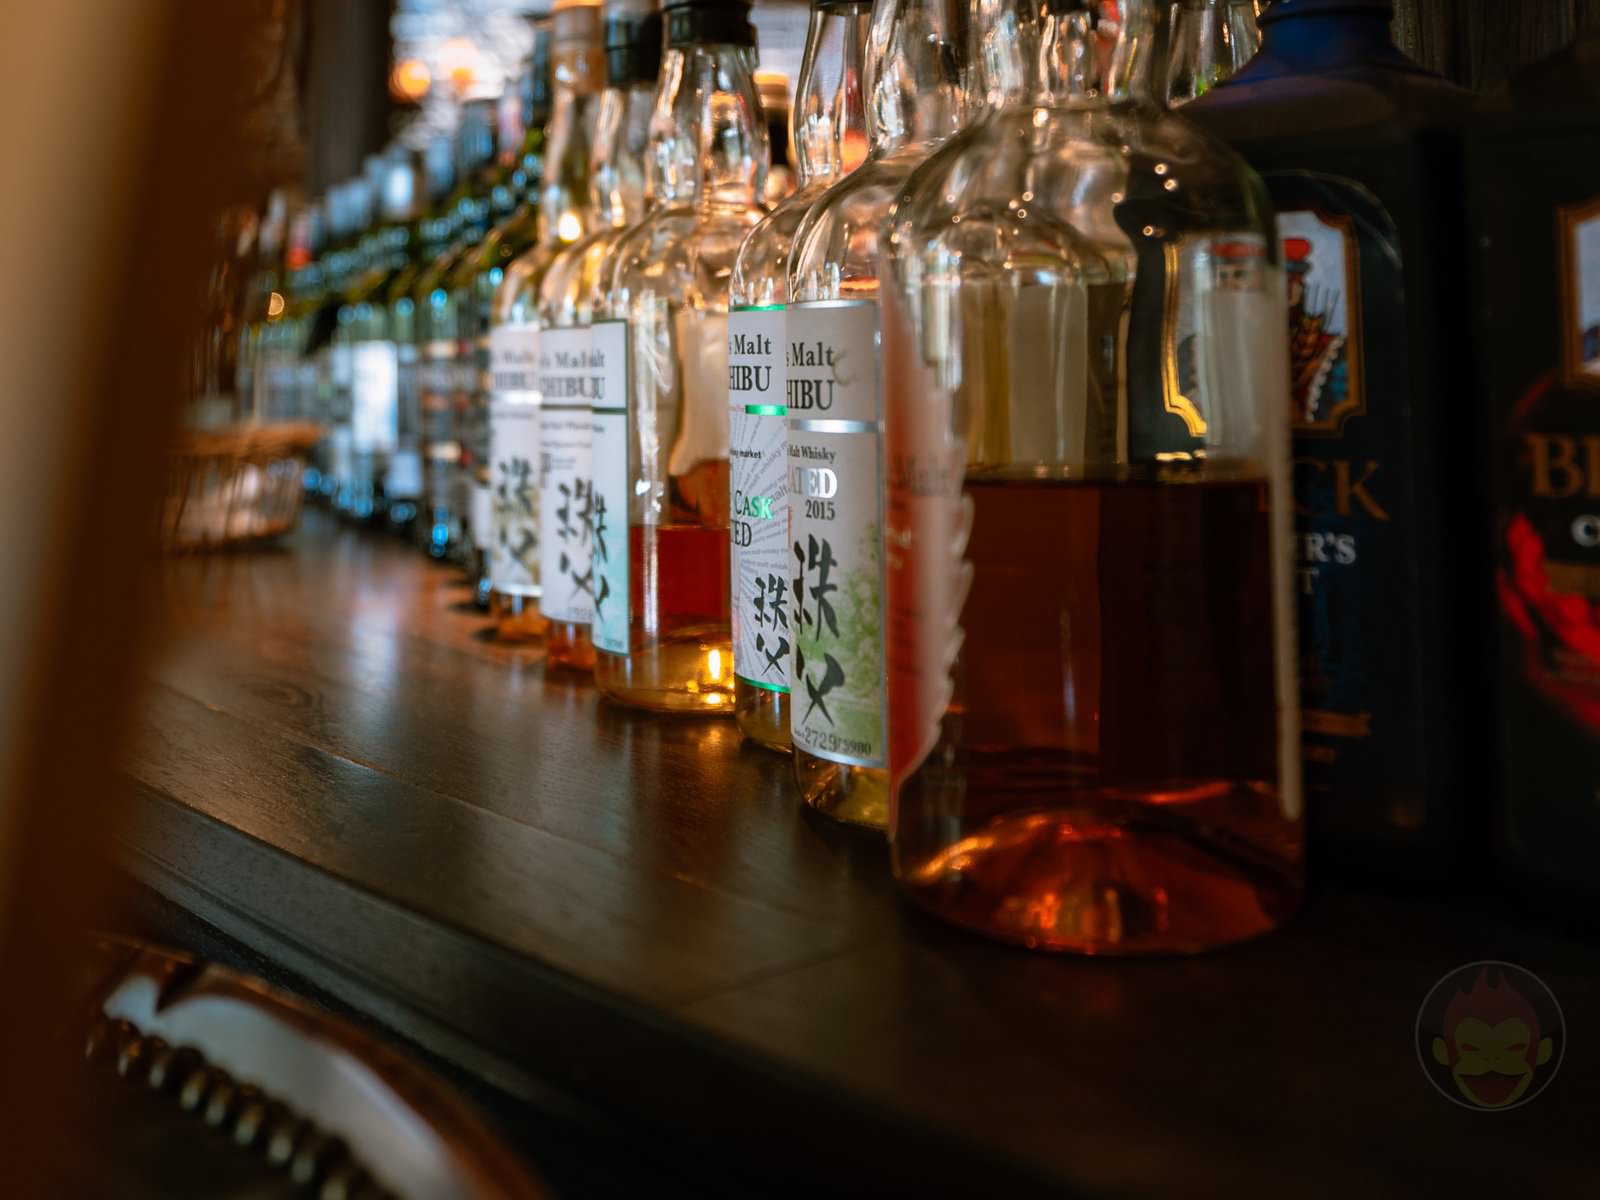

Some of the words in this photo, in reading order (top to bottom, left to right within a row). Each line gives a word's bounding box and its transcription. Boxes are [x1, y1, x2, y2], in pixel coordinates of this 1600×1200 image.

[734, 333, 772, 356] Malt
[792, 341, 836, 367] Malt
[555, 351, 593, 369] Mal
[802, 445, 836, 464] Whisky
[734, 489, 774, 520] CASK
[805, 499, 836, 521] 2015
[753, 573, 791, 676] 秩父
[793, 533, 846, 727] 秩父
